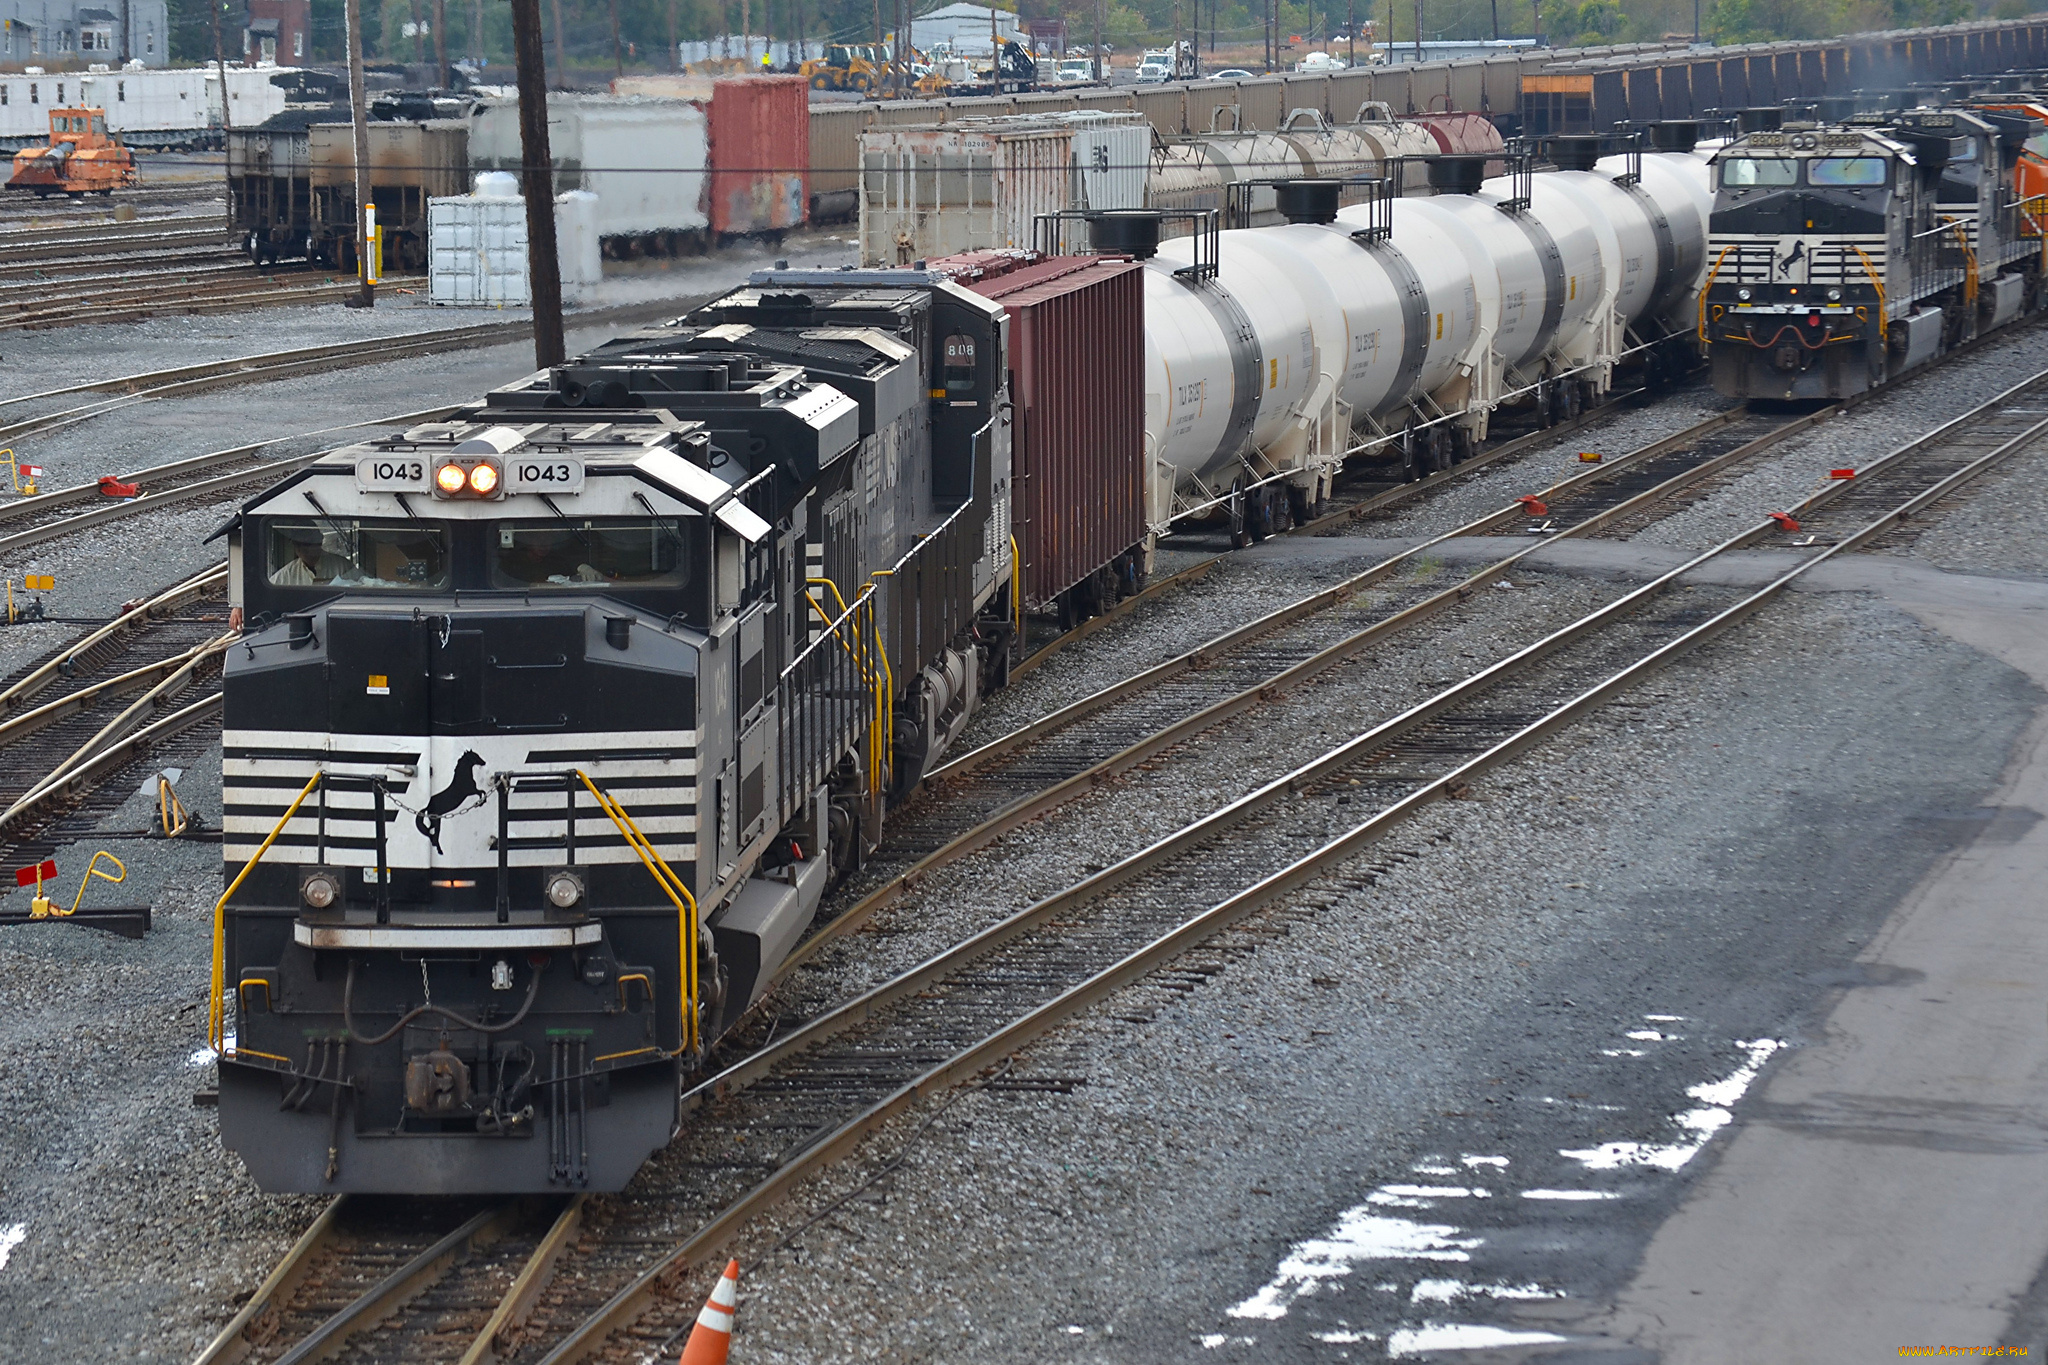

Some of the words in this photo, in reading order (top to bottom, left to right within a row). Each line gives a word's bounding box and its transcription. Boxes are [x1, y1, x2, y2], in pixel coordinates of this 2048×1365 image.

[1753, 135, 1781, 146] 9908
[373, 463, 423, 481] 1043
[519, 465, 570, 482] 1043
